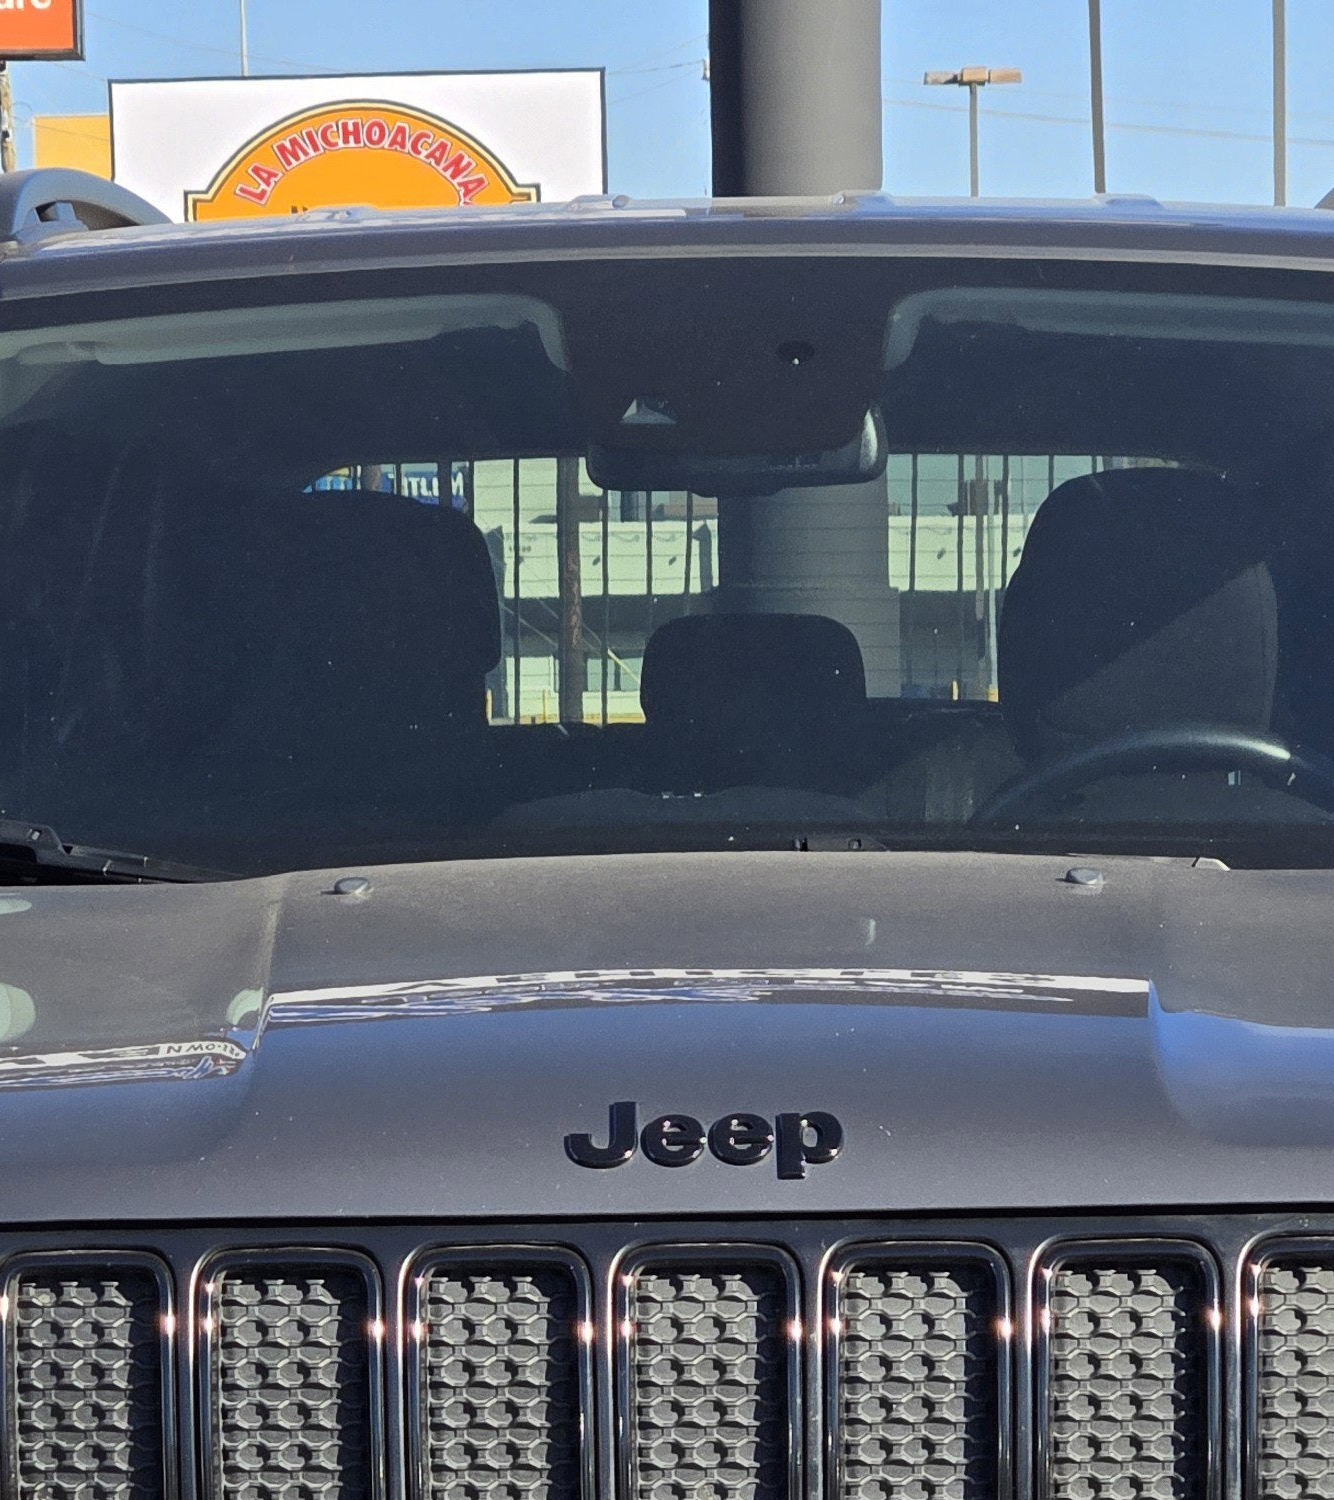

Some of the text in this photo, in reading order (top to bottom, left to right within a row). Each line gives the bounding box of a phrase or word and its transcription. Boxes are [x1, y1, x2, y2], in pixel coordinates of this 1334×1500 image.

[236, 117, 490, 207] LA MICHOACANA
[564, 1100, 844, 1180] Jeep
